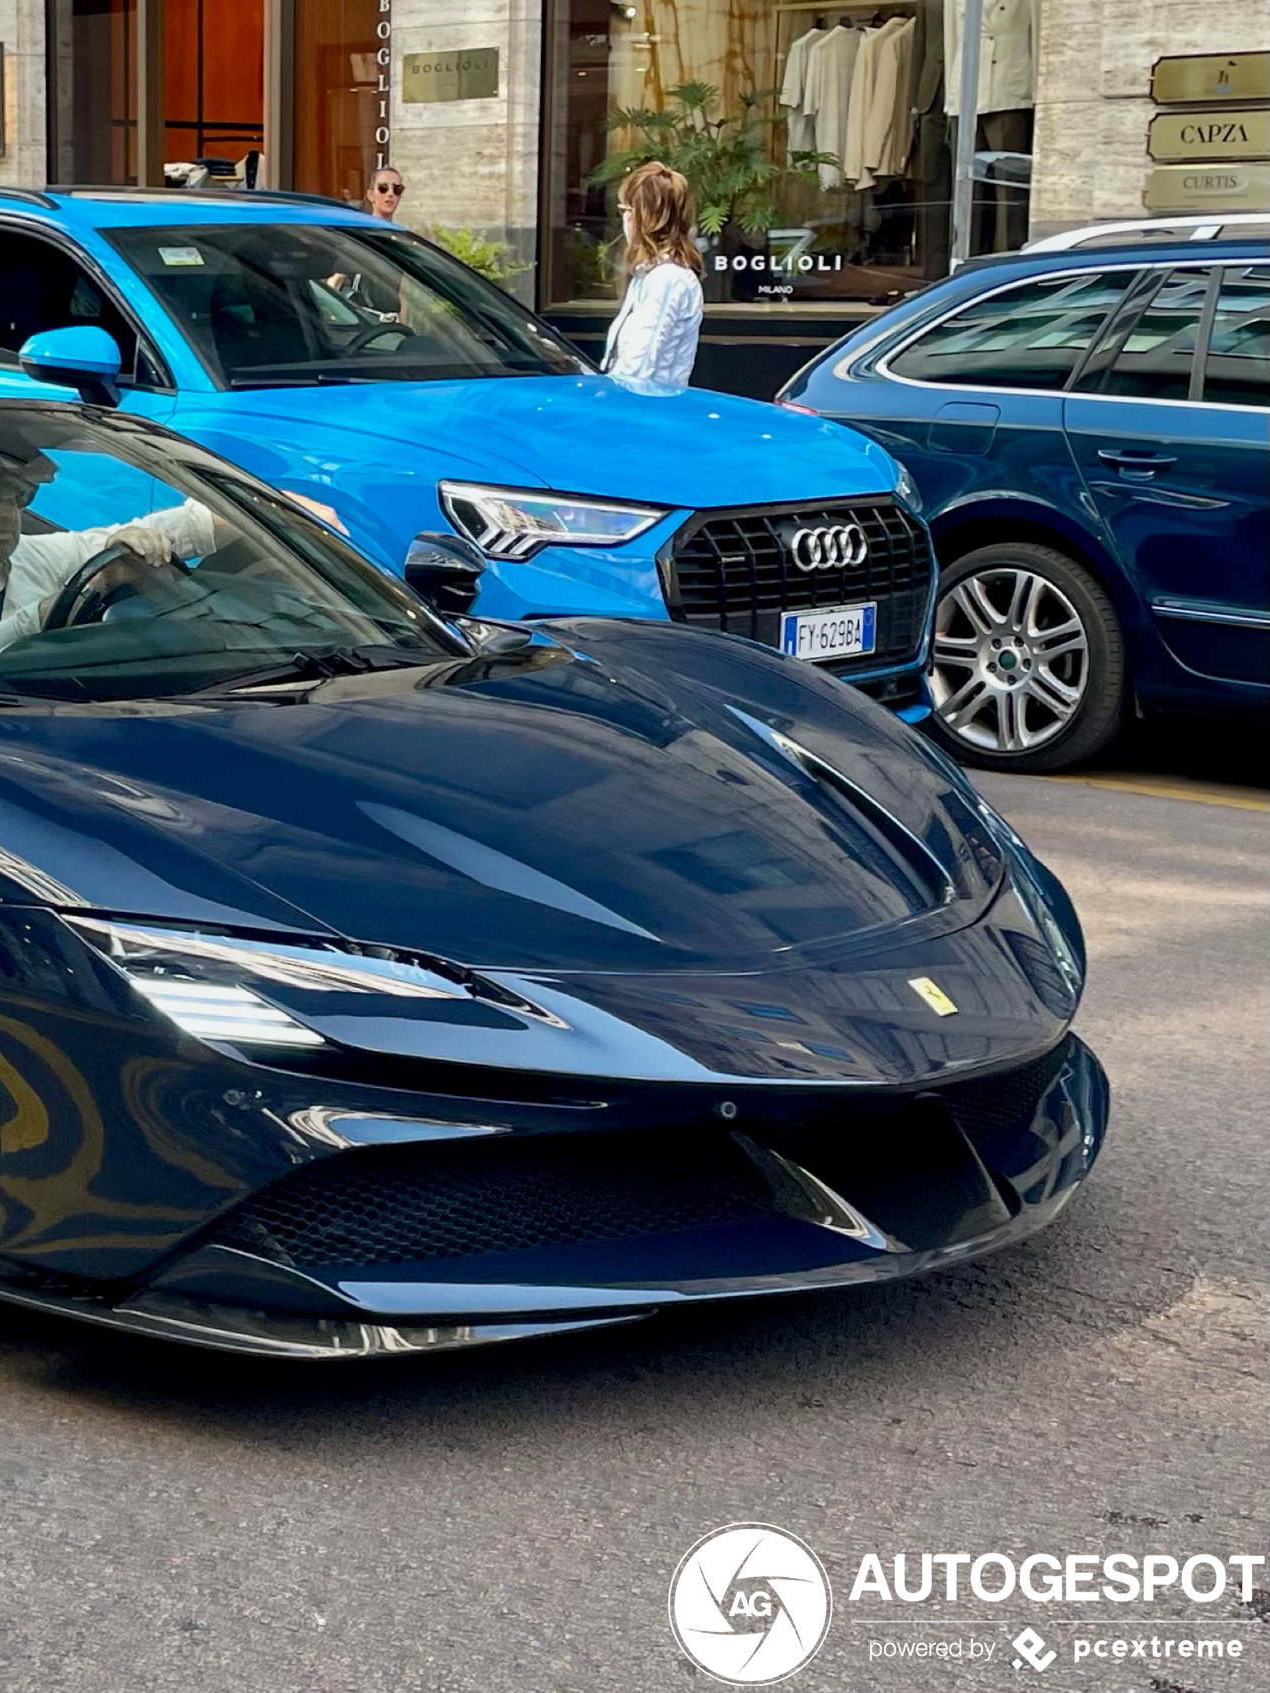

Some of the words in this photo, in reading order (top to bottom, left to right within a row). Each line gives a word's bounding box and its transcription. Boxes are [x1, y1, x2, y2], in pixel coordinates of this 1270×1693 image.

[412, 60, 489, 75] BOGLIOLI
[375, 0, 391, 170] BOGLIOL
[1183, 175, 1239, 190] CURTIS
[714, 255, 842, 271] BOGLIOLI
[758, 285, 794, 294] MILANO
